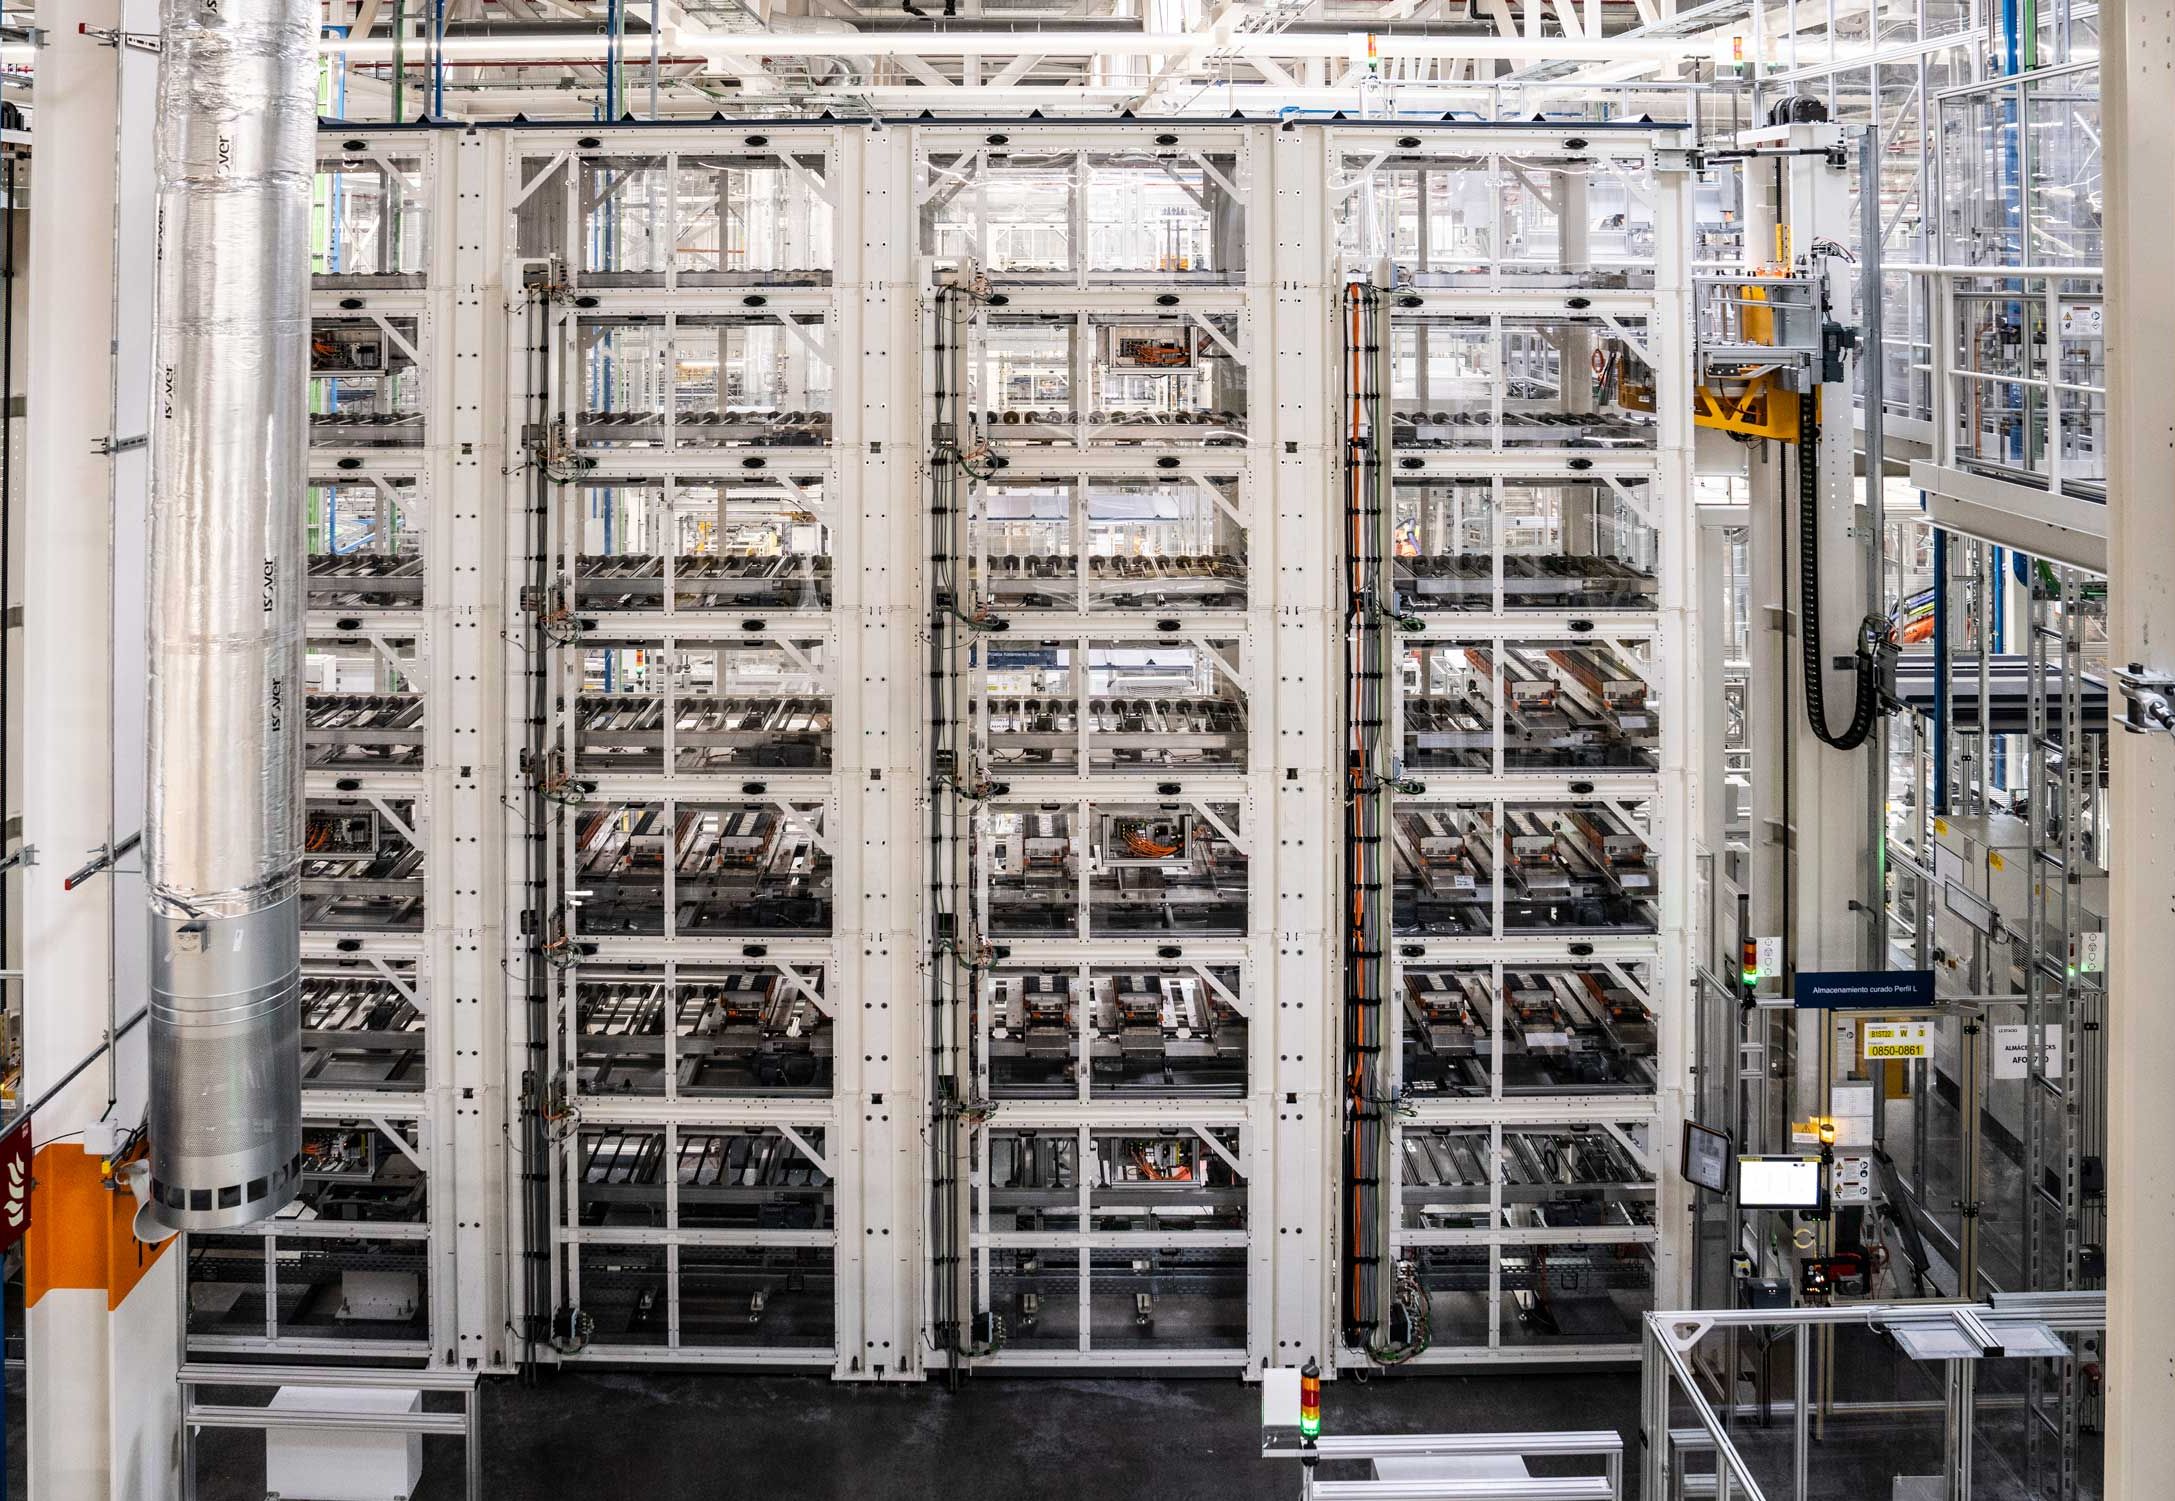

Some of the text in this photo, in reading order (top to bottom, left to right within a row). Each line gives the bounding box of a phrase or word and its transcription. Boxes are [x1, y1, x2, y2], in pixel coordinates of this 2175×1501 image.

[1812, 986, 1868, 994] Almacenamiento
[1900, 1030, 1908, 1038] W
[1872, 1045, 1920, 1056] 0850-0861
